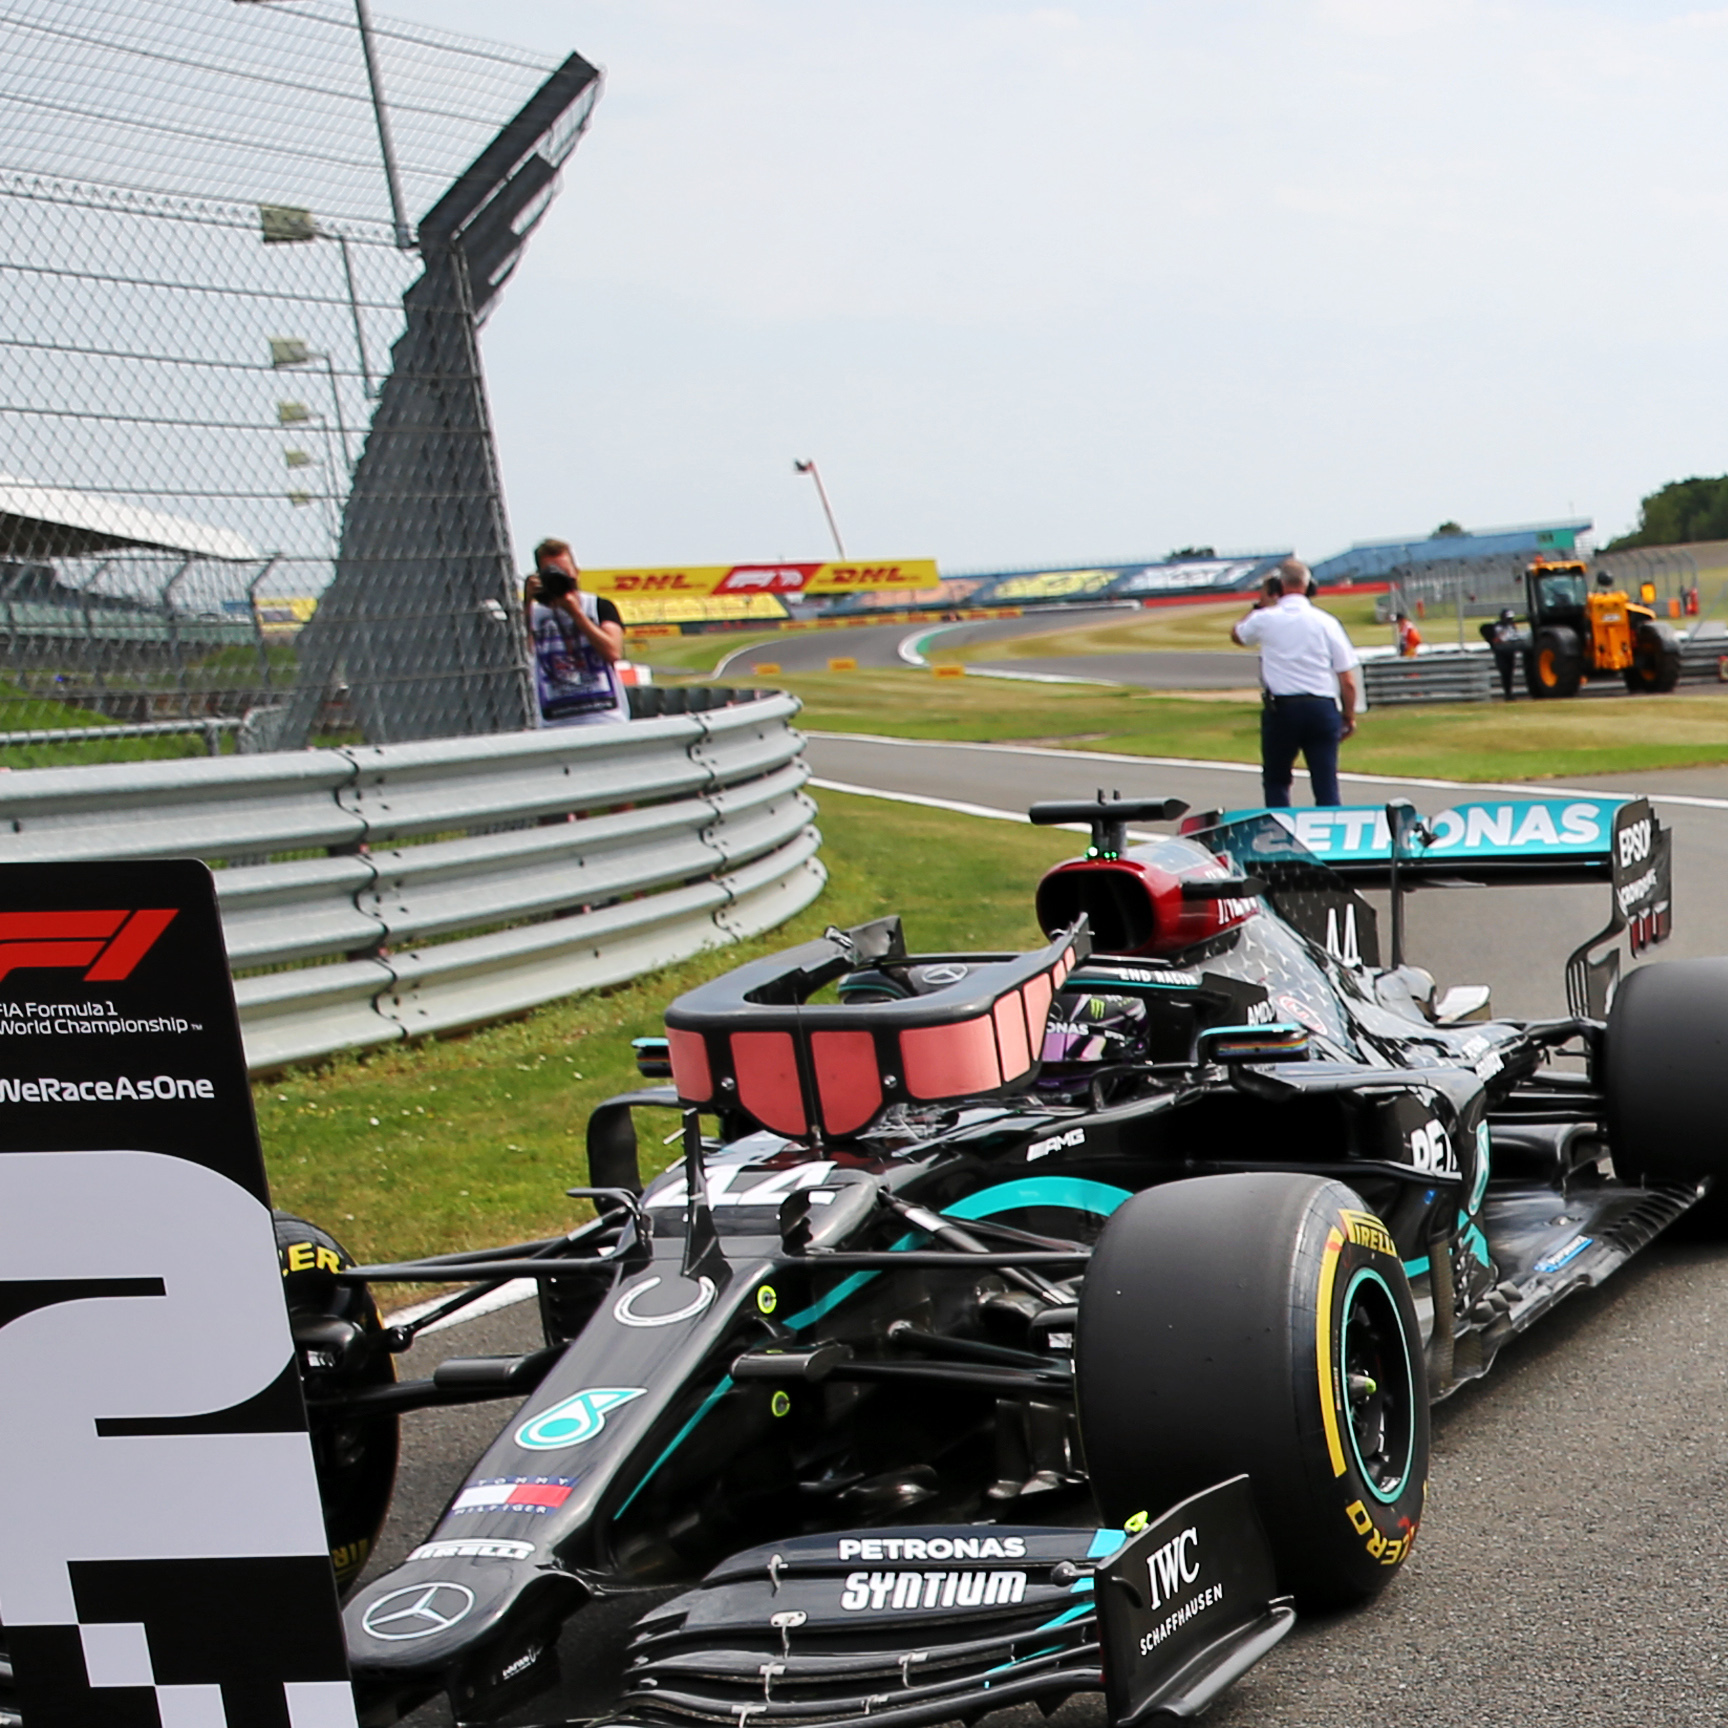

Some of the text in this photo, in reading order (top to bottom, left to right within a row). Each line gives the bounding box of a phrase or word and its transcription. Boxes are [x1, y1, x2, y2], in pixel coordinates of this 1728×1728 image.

[25, 1000, 104, 1018] Formula
[106, 1001, 119, 1017] 1
[0, 1019, 51, 1036] World
[54, 1016, 189, 1036] Championship
[0, 1075, 215, 1103] WeRaceAsOne
[477, 1476, 570, 1487] TOMMY
[453, 1504, 549, 1516] HILFIGER
[405, 1538, 536, 1562] PIRELLI
[838, 1536, 1028, 1561] PETRONAS
[1145, 1526, 1201, 1612] IWC
[840, 1570, 1028, 1612] SYNTIUM
[1139, 1582, 1224, 1657] SCHAFFHAUSEN
